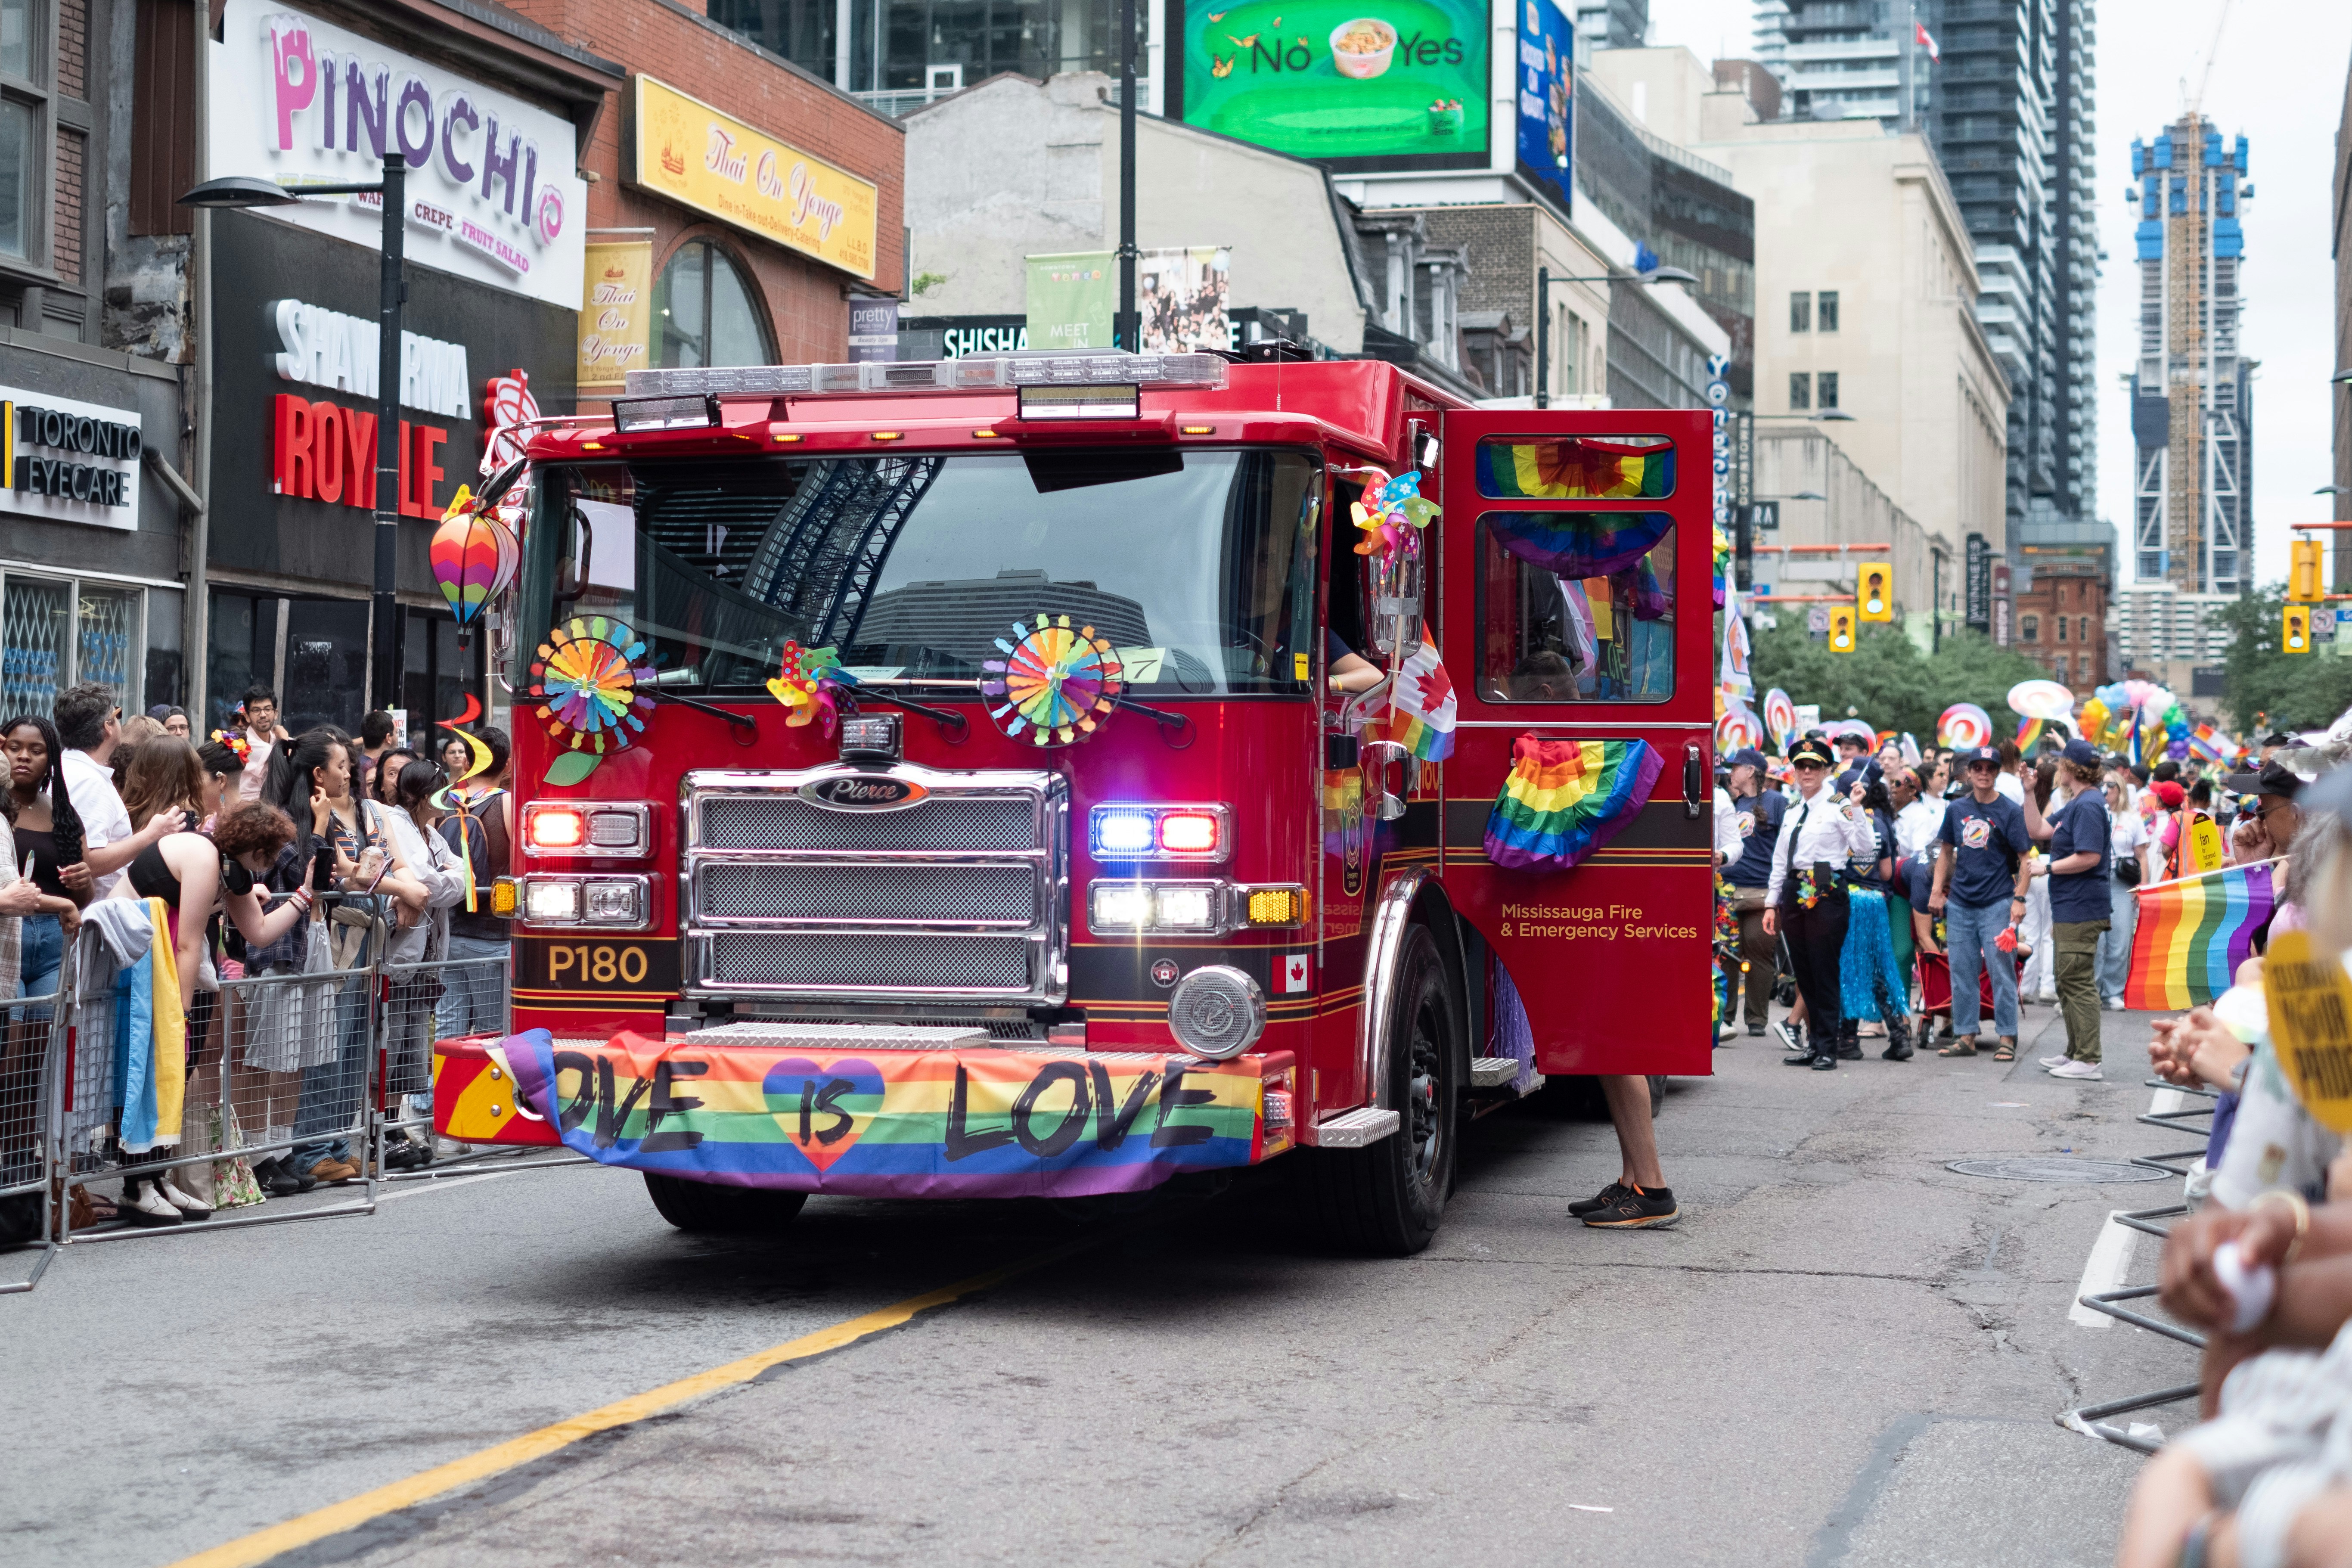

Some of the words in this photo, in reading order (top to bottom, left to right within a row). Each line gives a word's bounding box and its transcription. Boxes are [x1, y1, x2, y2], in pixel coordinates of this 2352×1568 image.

[1252, 39, 1311, 73] No
[1398, 32, 1463, 66] Yes
[705, 127, 747, 183] Thai
[757, 151, 782, 199] On
[790, 164, 843, 240] Yonge
[415, 203, 453, 230] CREPE
[461, 220, 494, 250] FRUIT
[495, 239, 529, 273] SALAD
[592, 284, 636, 304] Thai
[599, 309, 627, 329] On
[853, 307, 893, 331] pretty
[1050, 323, 1089, 337] MEET
[582, 335, 644, 364] Yonge
[944, 327, 1029, 359] SHISHA
[1073, 338, 1089, 348] IN
[276, 299, 471, 420] SHAWRMA
[16, 406, 143, 460] TORONTO
[274, 393, 447, 521] ROYLE
[16, 456, 130, 507] EYECARE
[1969, 540, 1980, 620] WINNERS
[1132, 659, 1158, 679] 7
[828, 779, 898, 802] Pierce
[2199, 833, 2209, 846] fan
[1502, 904, 1603, 922] Mississauga
[1610, 904, 1642, 919] Fire
[1501, 922, 1513, 937] &
[1519, 922, 1618, 940] Emergency
[1624, 924, 1697, 938] Services
[549, 946, 648, 983] P180
[554, 1051, 709, 1153] OVE
[799, 1078, 856, 1146] IS
[943, 1060, 1217, 1162] LOVE
